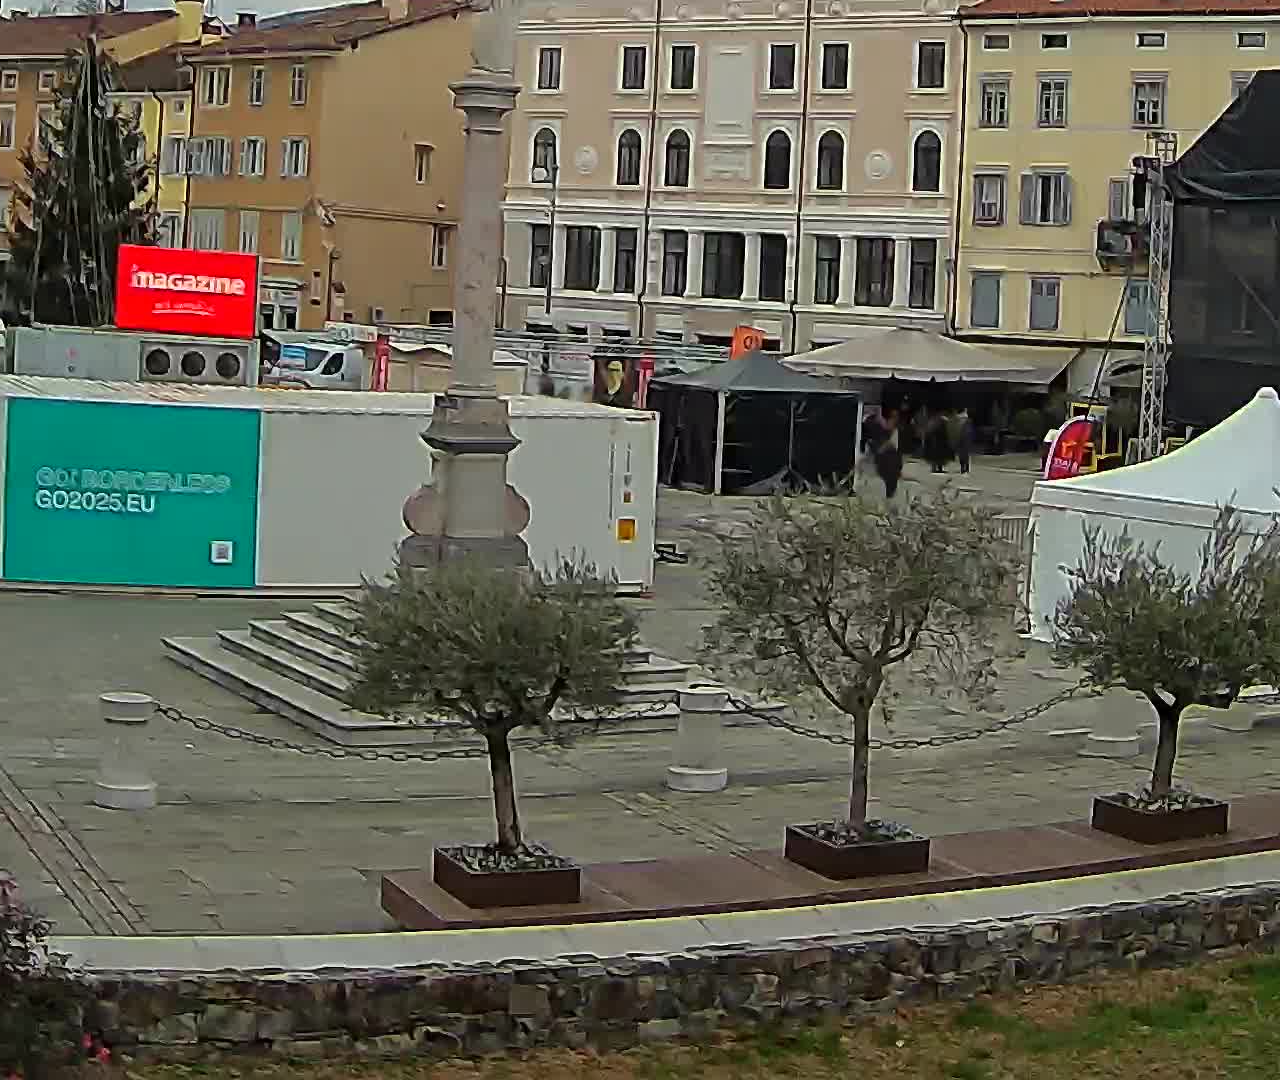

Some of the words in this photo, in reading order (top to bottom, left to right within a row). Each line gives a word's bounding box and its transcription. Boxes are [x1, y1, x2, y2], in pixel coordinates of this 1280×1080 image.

[35, 466, 77, 488] GO!
[81, 468, 232, 494] BORDERLESS
[35, 489, 156, 513] GO2025.EU
